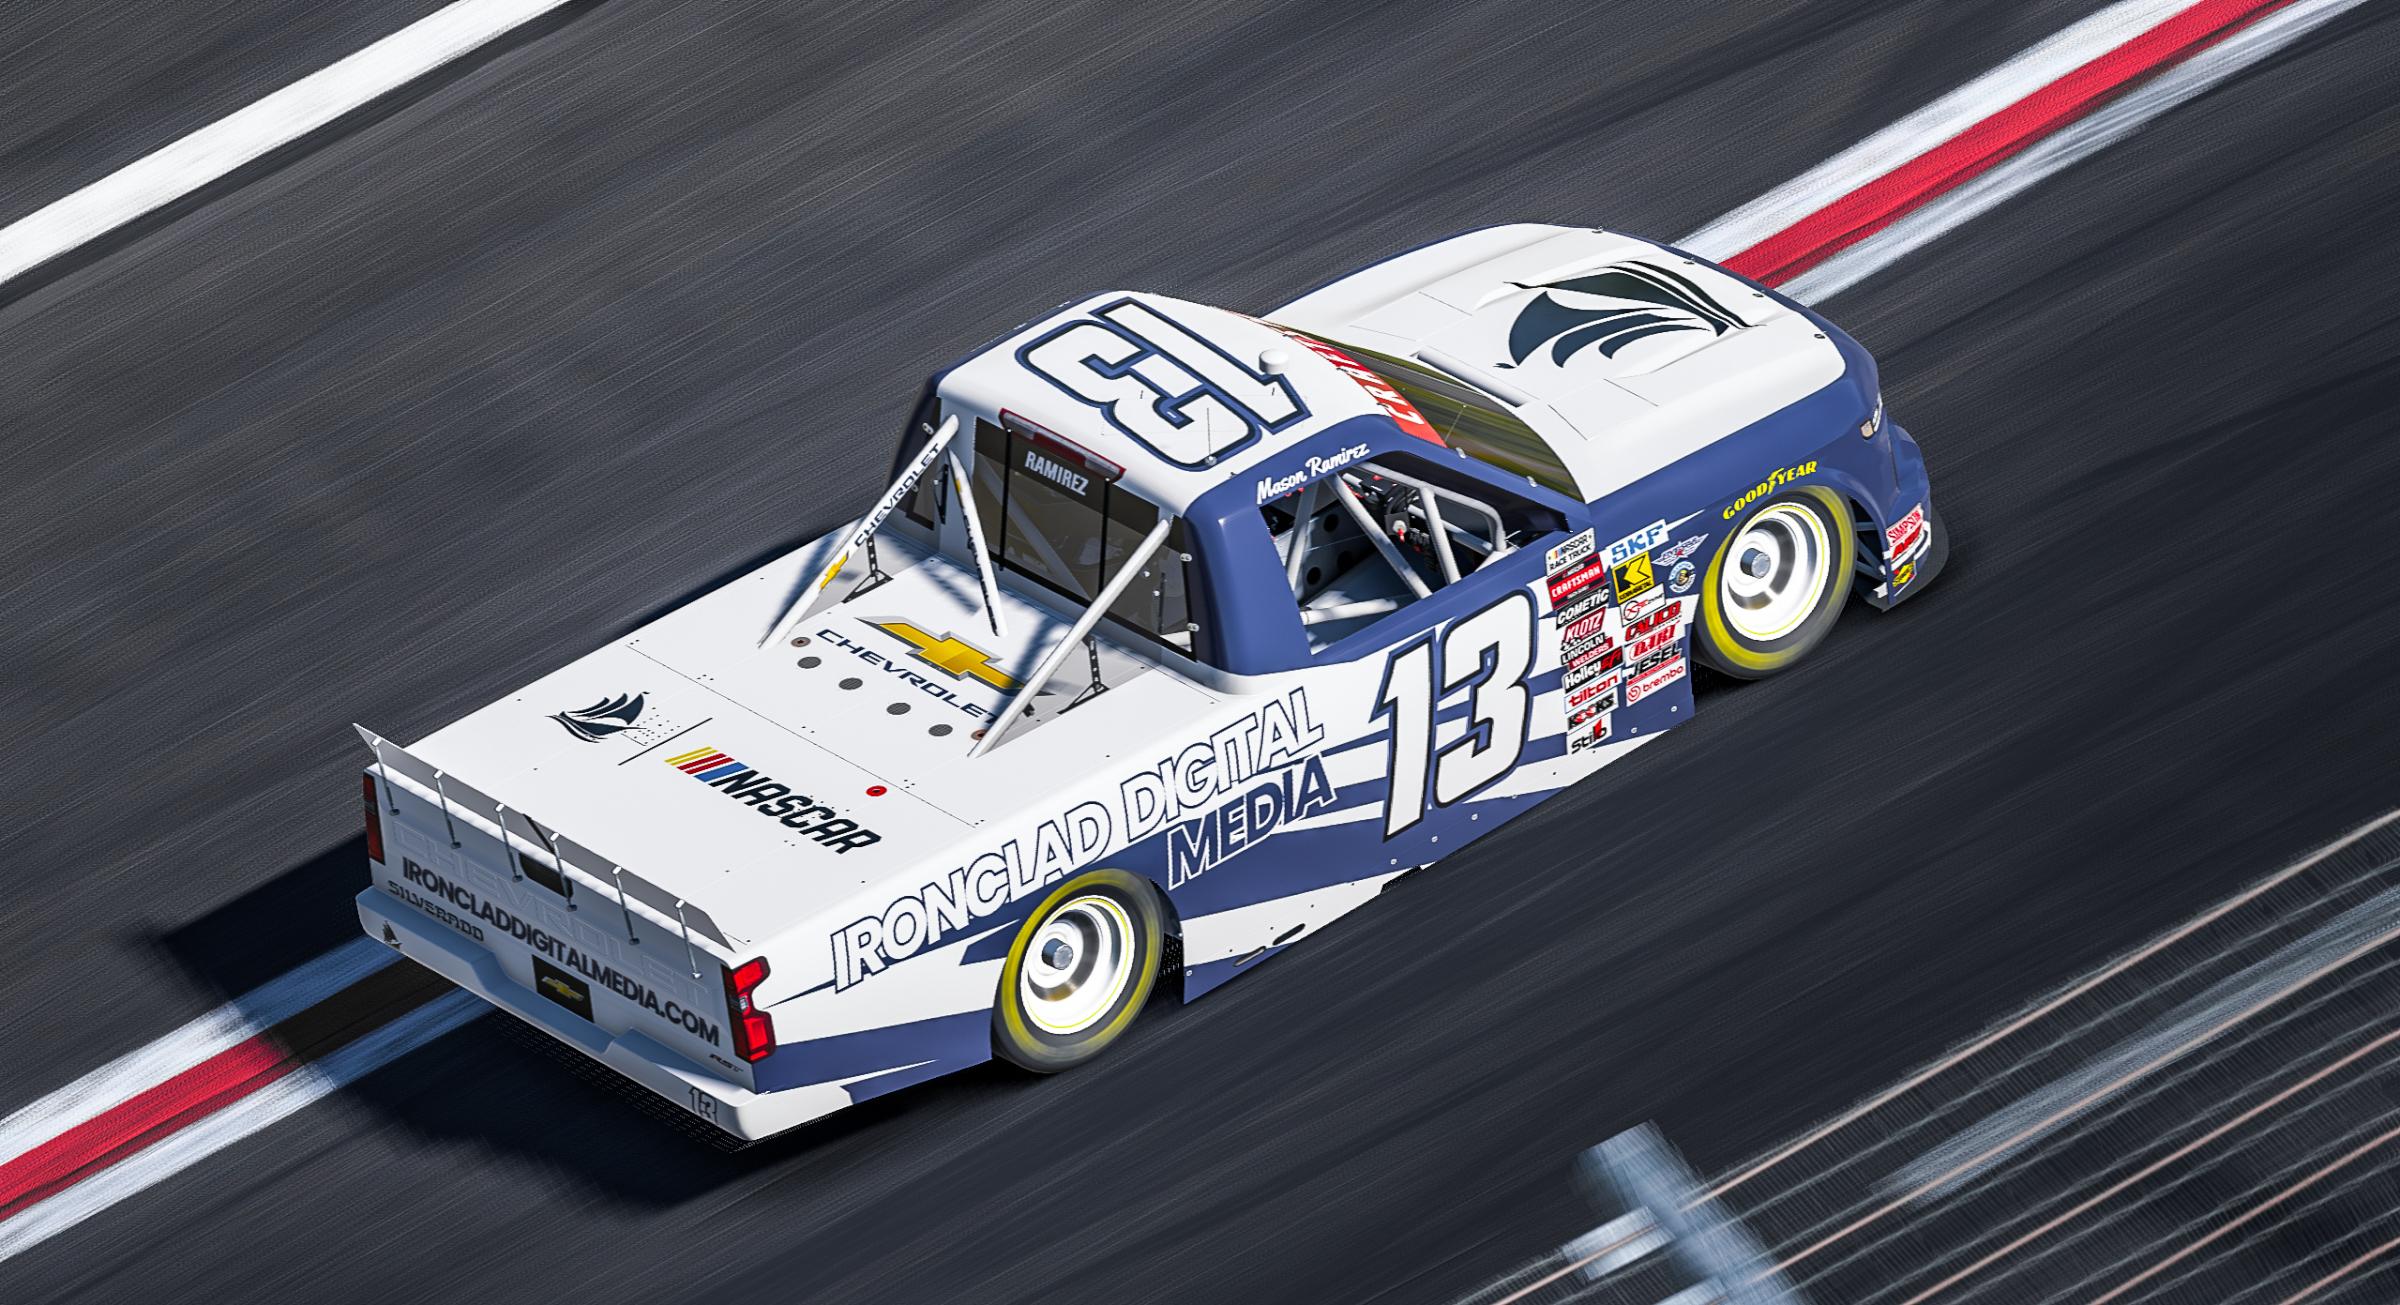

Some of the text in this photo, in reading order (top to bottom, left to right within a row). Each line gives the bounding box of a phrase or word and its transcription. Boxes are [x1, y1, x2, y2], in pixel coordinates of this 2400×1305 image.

[1014, 296, 1313, 473] 13
[1024, 450, 1090, 496] RAMIREZ
[1256, 443, 1370, 505] Mason Ramirez
[1722, 460, 1818, 520] GOODYEAR
[853, 443, 940, 548] CHEVROLET
[1549, 556, 1567, 571] RACE
[1568, 544, 1591, 561] TRUCK
[1611, 524, 1664, 564] SKF
[1551, 565, 1601, 598] CRAFTSMAN
[1557, 588, 1610, 625] COMETIC
[1565, 611, 1604, 643] KLOTZ
[1624, 600, 1682, 642] CALICO
[1561, 634, 1605, 664] LINCOLN
[1571, 643, 1610, 667] WELDERS
[1628, 642, 1682, 680] JESEL
[1569, 675, 1618, 707] tilton
[1643, 666, 1684, 692] brembo
[1368, 589, 1539, 842] 13
[709, 769, 882, 855] NASCAR
[1166, 753, 1337, 892] MEDIA
[831, 686, 1326, 995] IRONCLAD DIGITAL
[388, 880, 484, 942] SILVERADO
[402, 856, 720, 1048] IRONCLADDIGITALMEDIA.COM
[709, 1053, 744, 1073] RST
